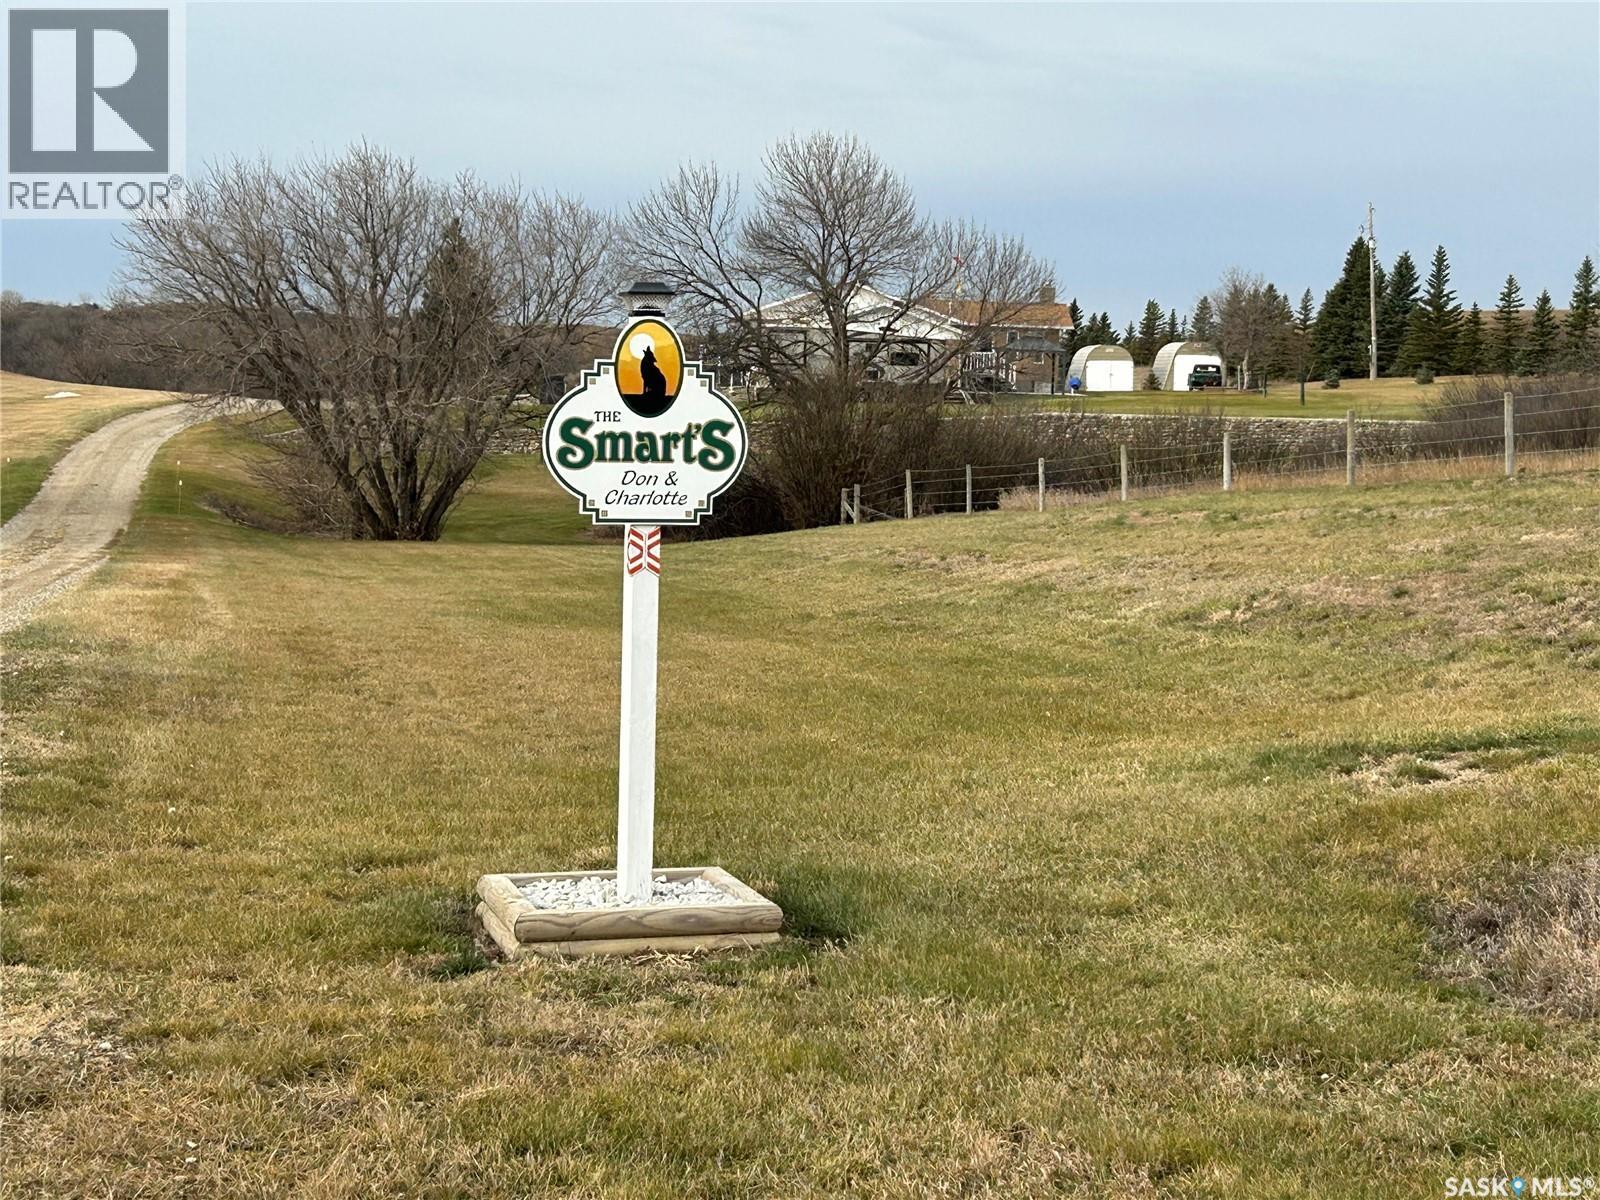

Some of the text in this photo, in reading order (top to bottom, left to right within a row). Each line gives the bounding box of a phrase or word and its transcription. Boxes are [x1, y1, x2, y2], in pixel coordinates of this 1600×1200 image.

[594, 411, 621, 422] THE
[621, 470, 679, 486] Don &
[604, 489, 688, 506] Charlotte
